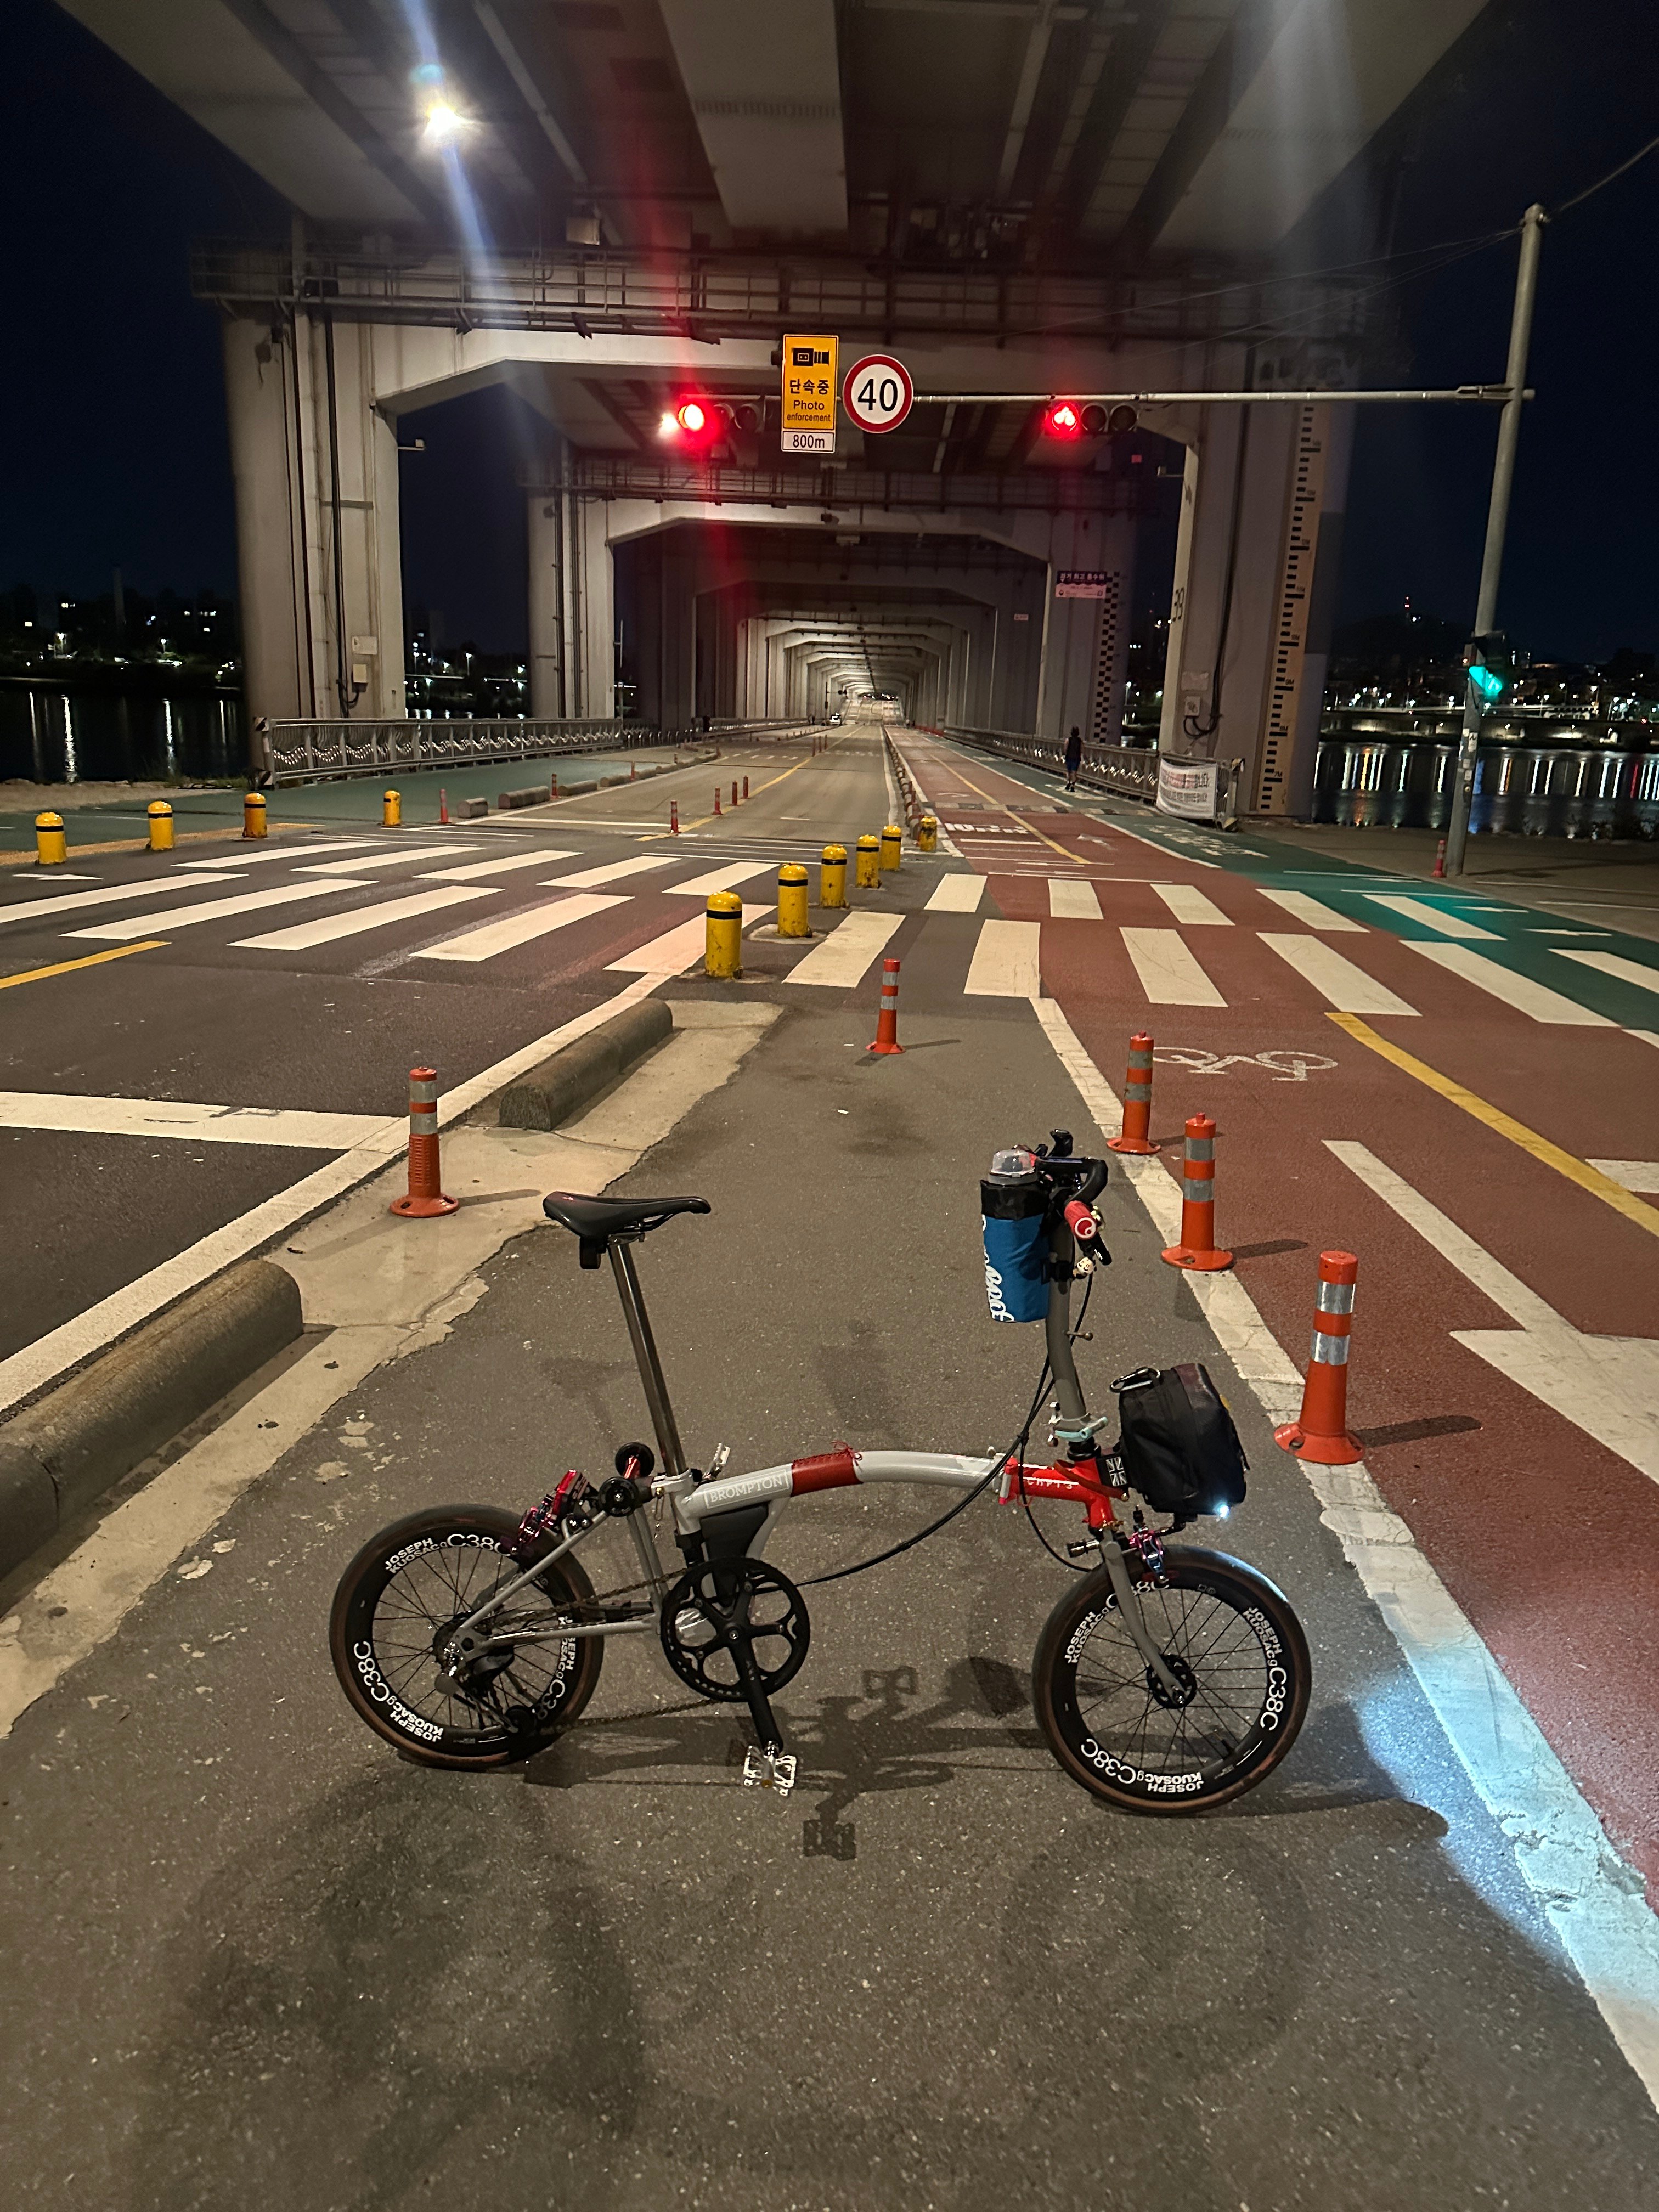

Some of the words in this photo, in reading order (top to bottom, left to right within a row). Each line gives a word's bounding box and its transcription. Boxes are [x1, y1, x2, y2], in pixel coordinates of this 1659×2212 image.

[789, 379, 830, 395] 단속중
[857, 379, 898, 411] 40
[787, 413, 831, 422] enforcement
[793, 400, 825, 410] Photo
[793, 435, 825, 448] 800m
[710, 1475, 783, 1503] BROMPTON
[385, 1538, 433, 1570] JOSEPH
[1064, 1611, 1096, 1663] JOSEPH
[1249, 1607, 1283, 1654] JOSEPH
[353, 1641, 390, 1701] C38C
[1260, 1667, 1287, 1731] C38C
[390, 1711, 442, 1742] JOSEPH
[1081, 1738, 1136, 1784] C38C
[1148, 1781, 1204, 1793] JOSEPH
